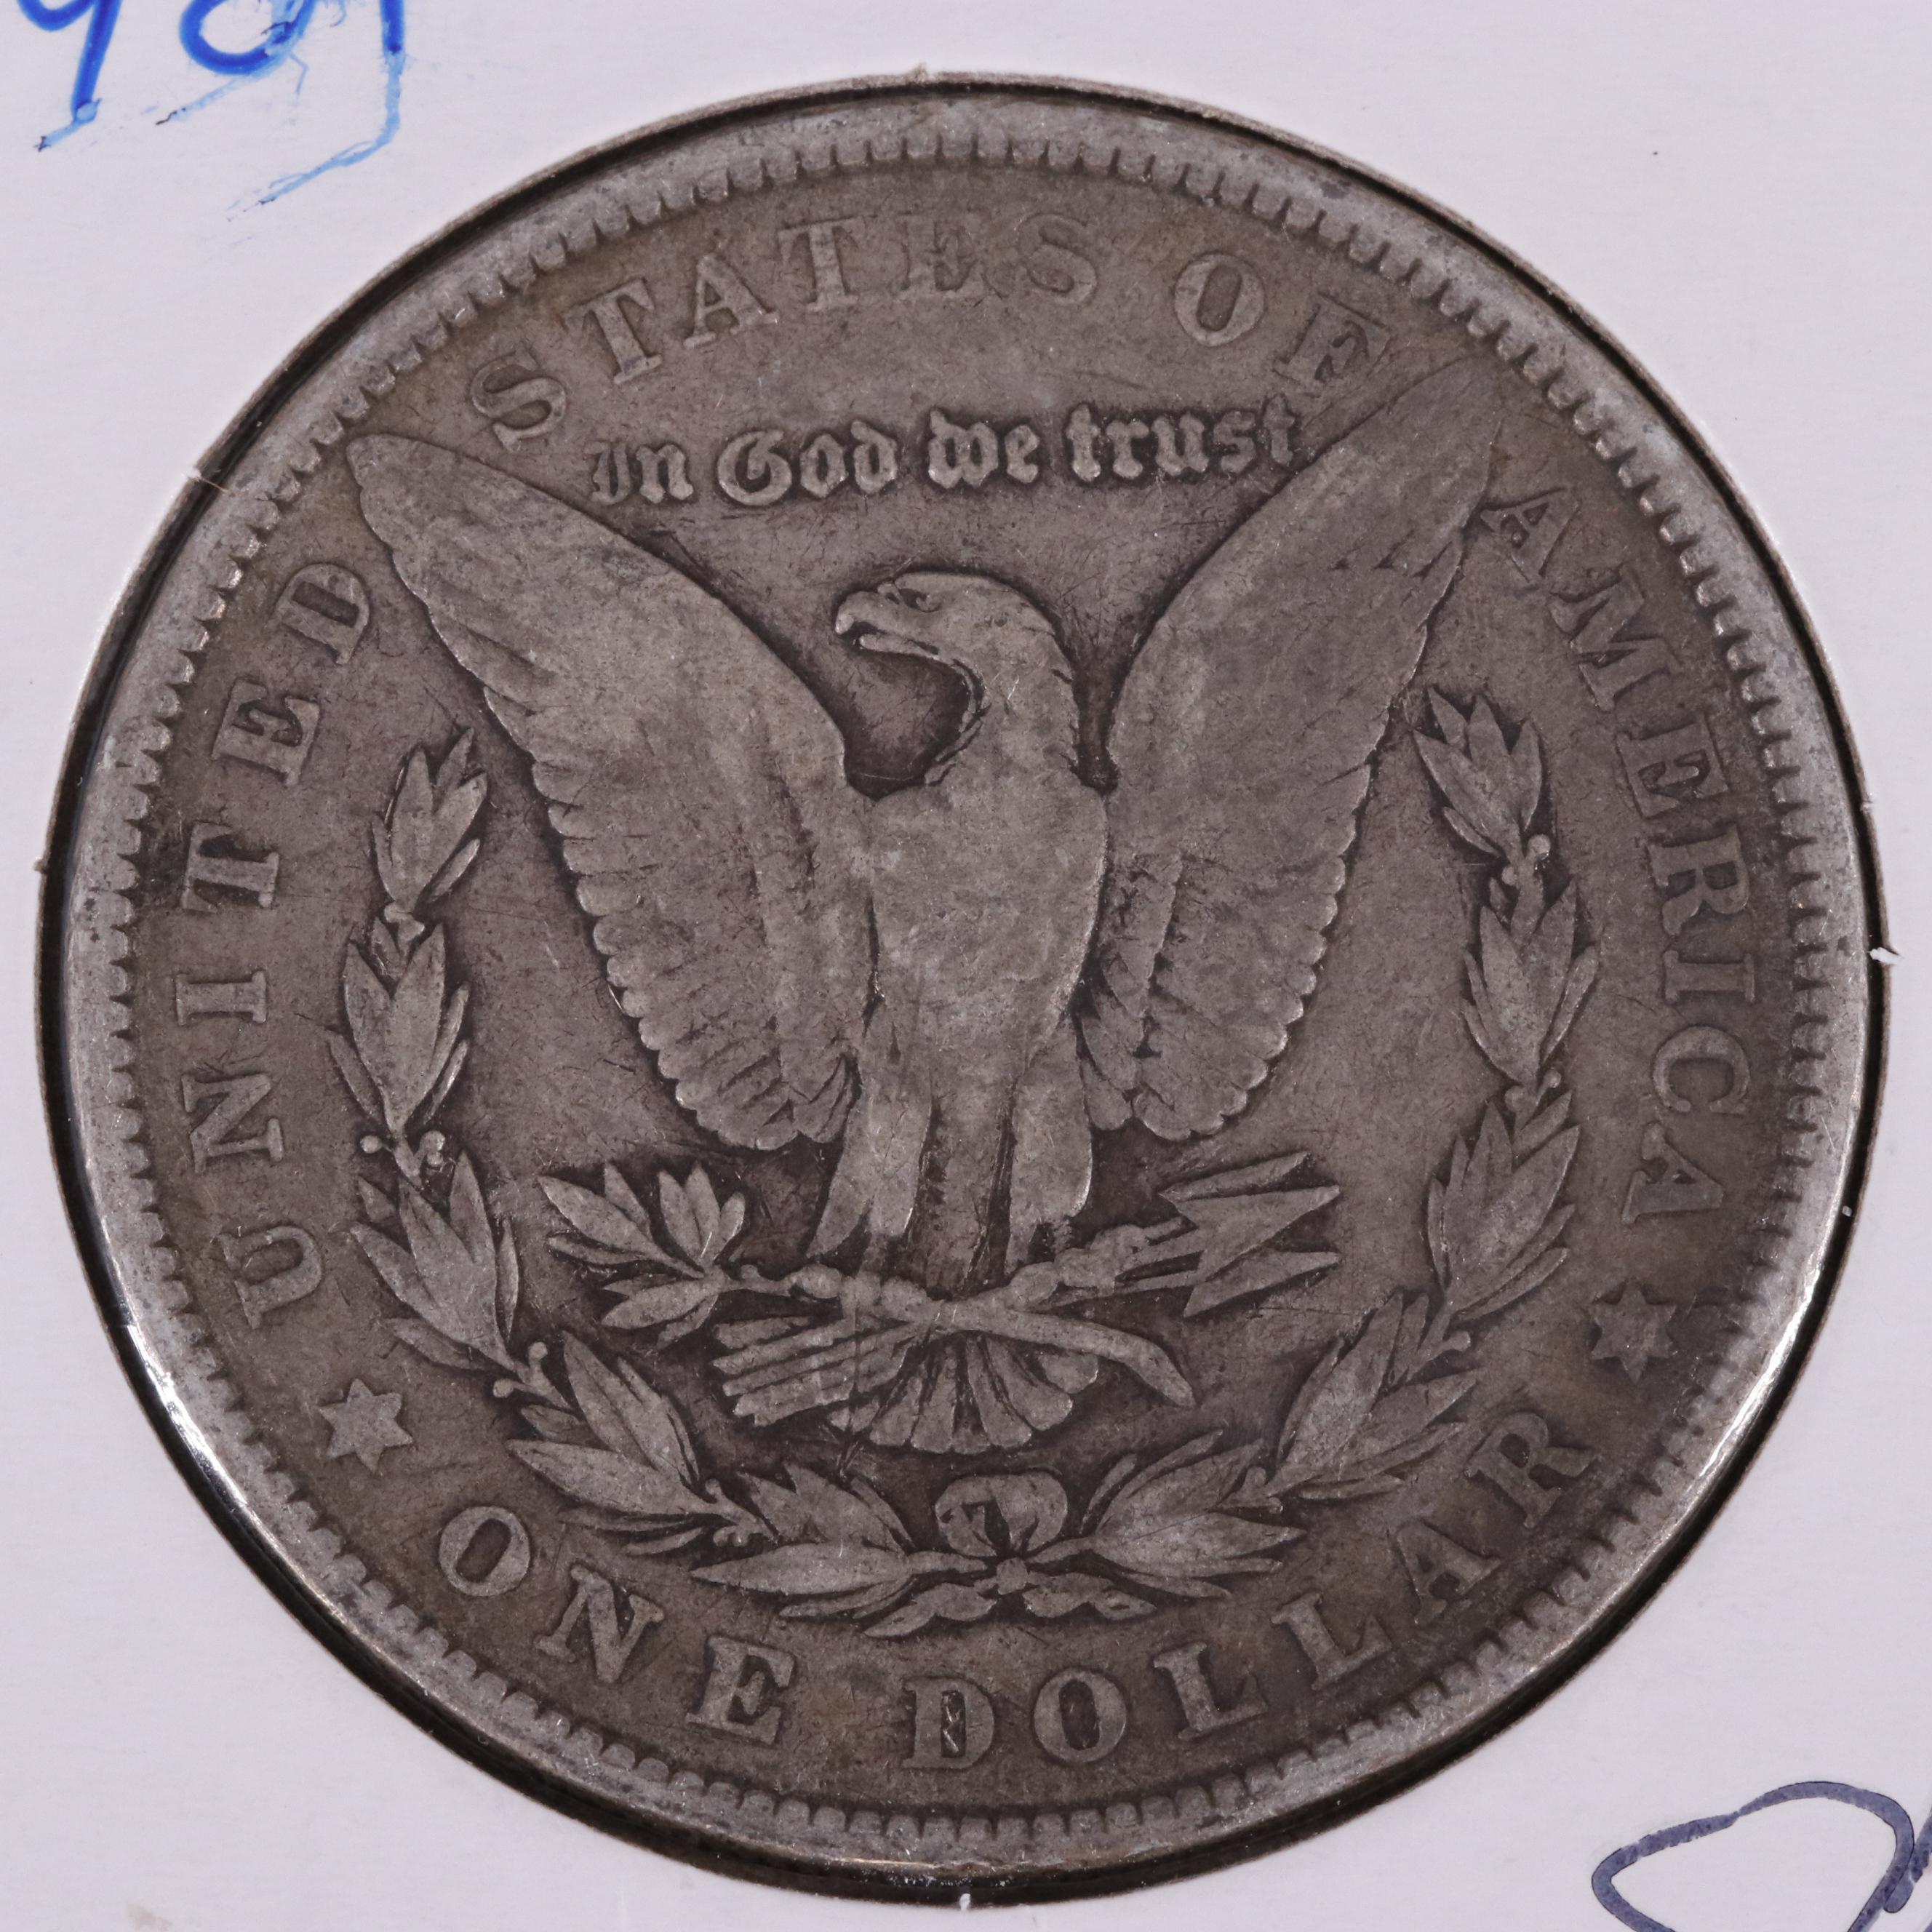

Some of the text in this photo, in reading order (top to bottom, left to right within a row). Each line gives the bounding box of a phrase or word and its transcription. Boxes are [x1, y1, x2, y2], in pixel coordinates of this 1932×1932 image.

[590, 394, 1304, 507] In God we trust
[174, 209, 1757, 1330] UNITED STATES OF AMERICA
[436, 1408, 1592, 1772] ONE DOLLAR
